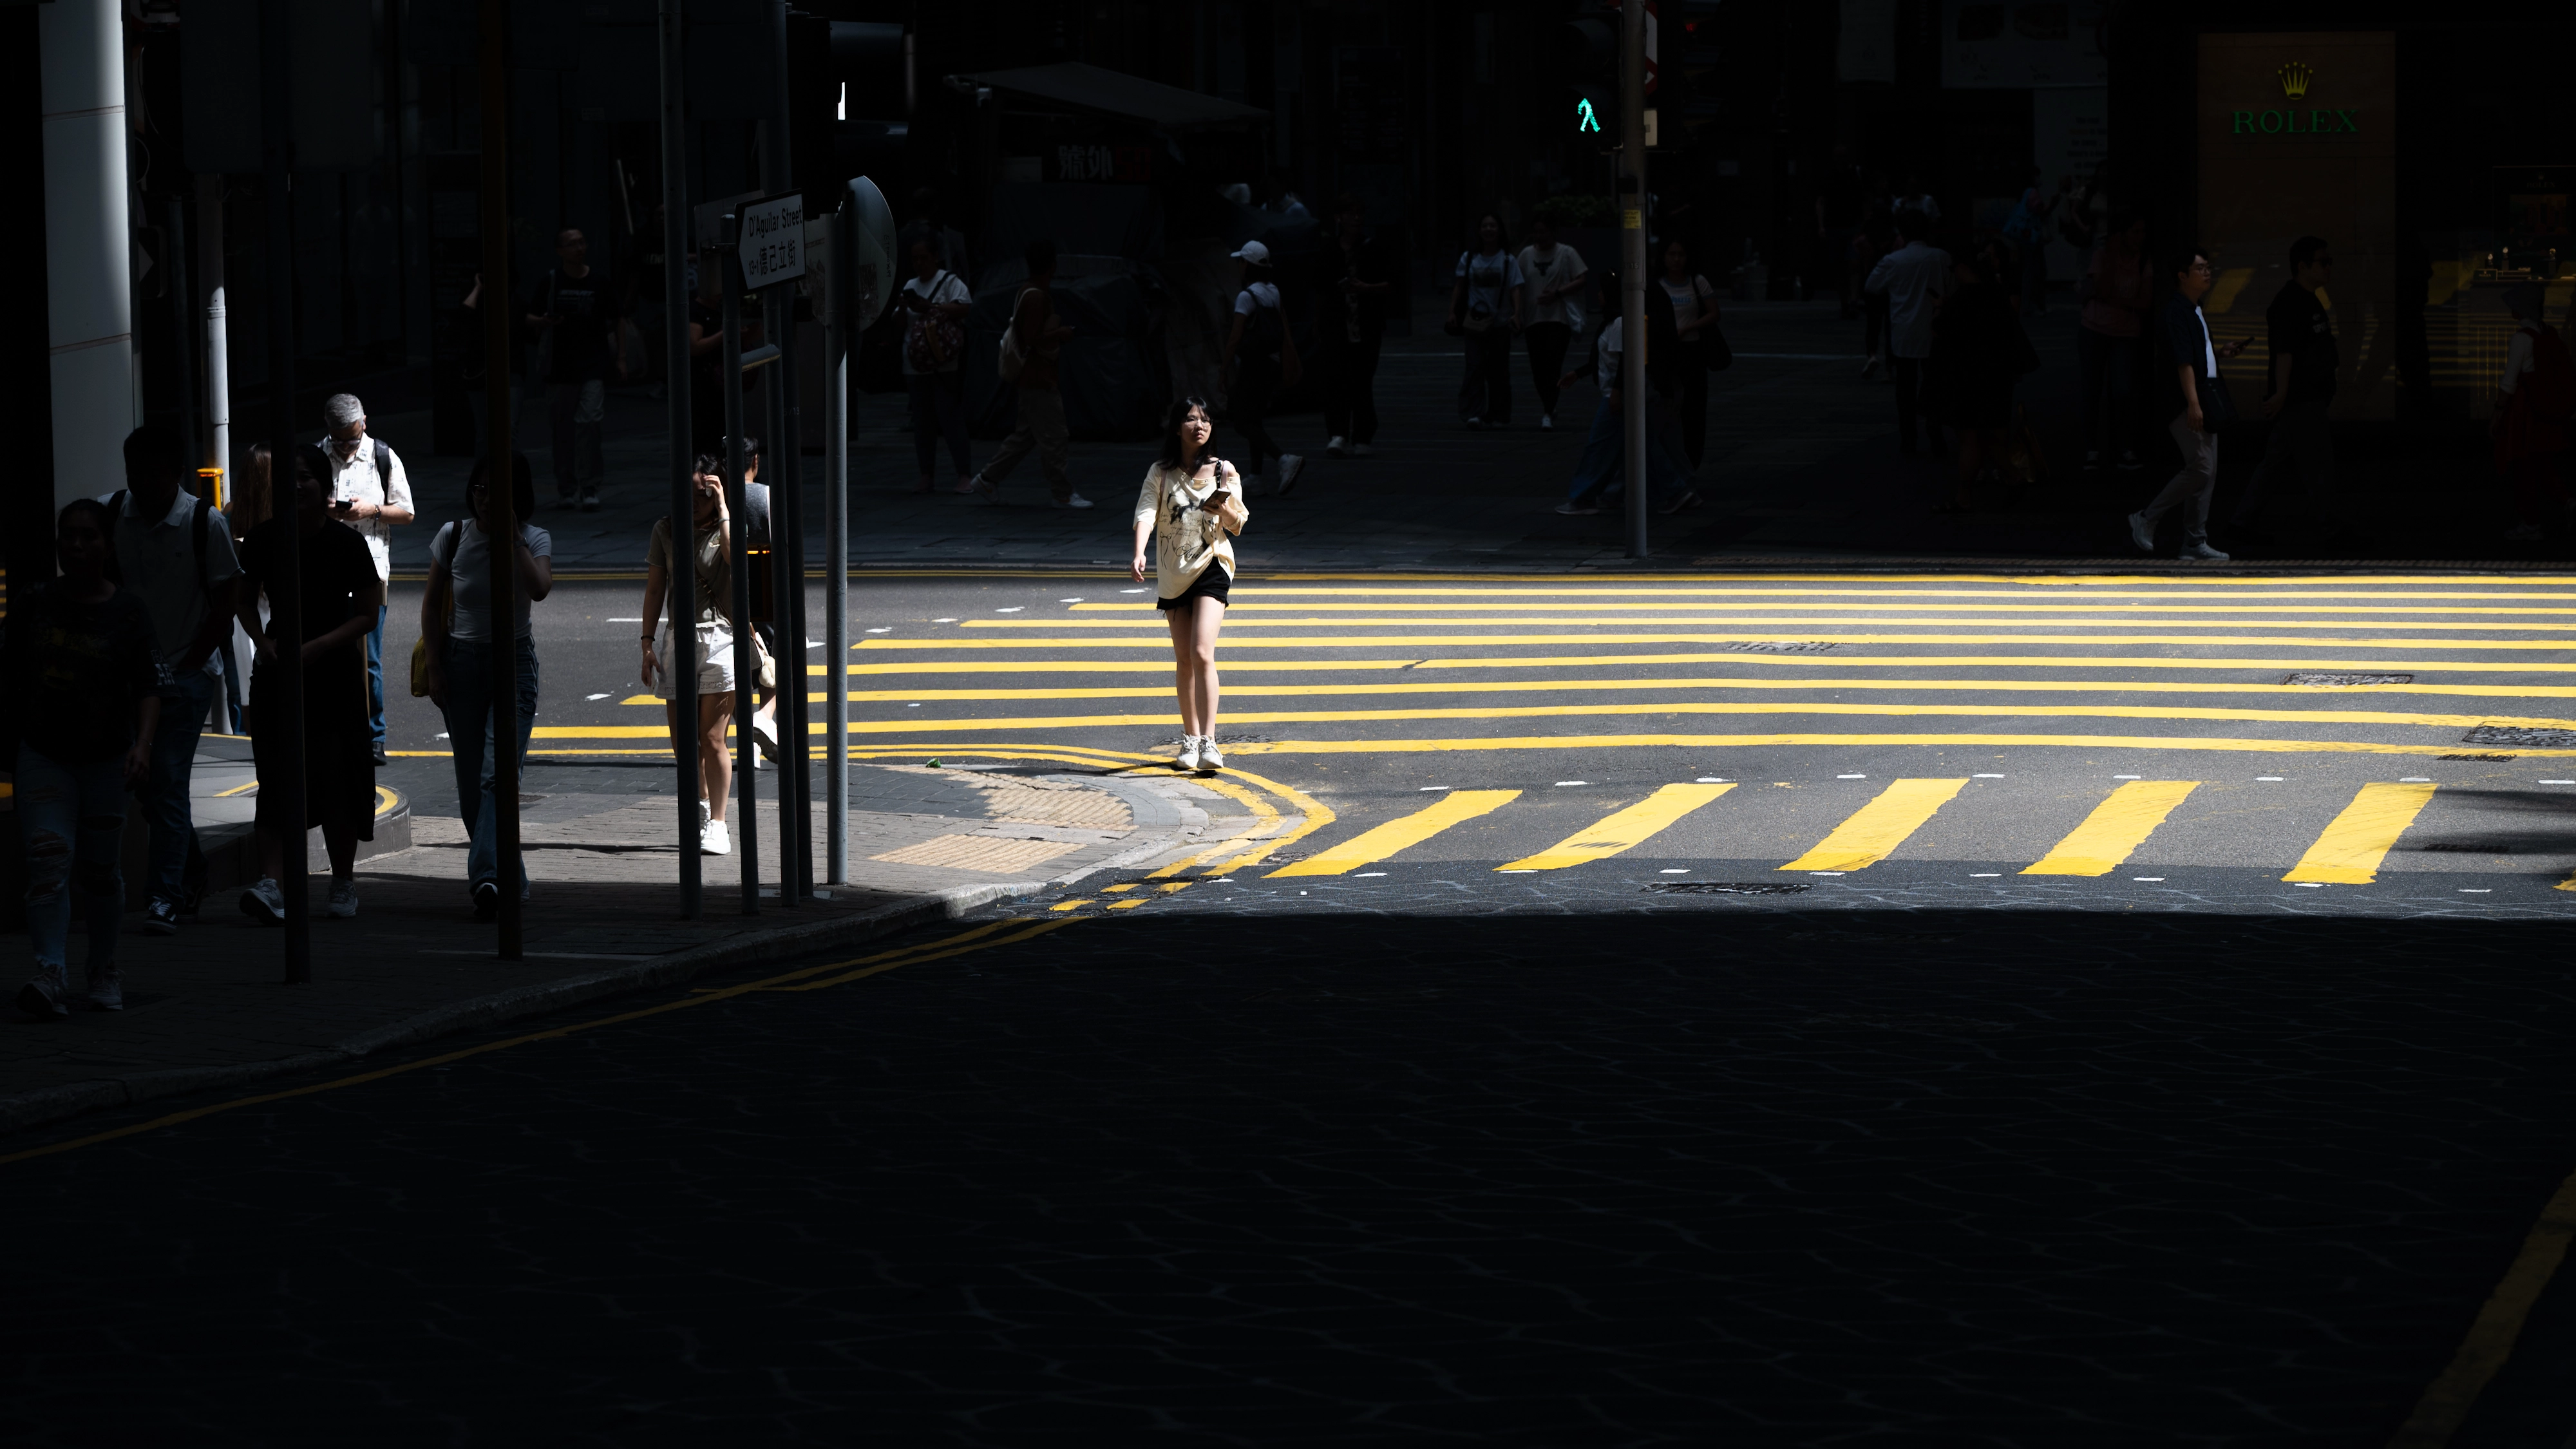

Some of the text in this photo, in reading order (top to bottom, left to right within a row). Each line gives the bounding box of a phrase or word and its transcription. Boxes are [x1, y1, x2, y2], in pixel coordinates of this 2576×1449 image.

[2231, 109, 2360, 134] ROLEX
[749, 204, 802, 239] D'Aguilar Street
[759, 238, 796, 276] 德己立街
